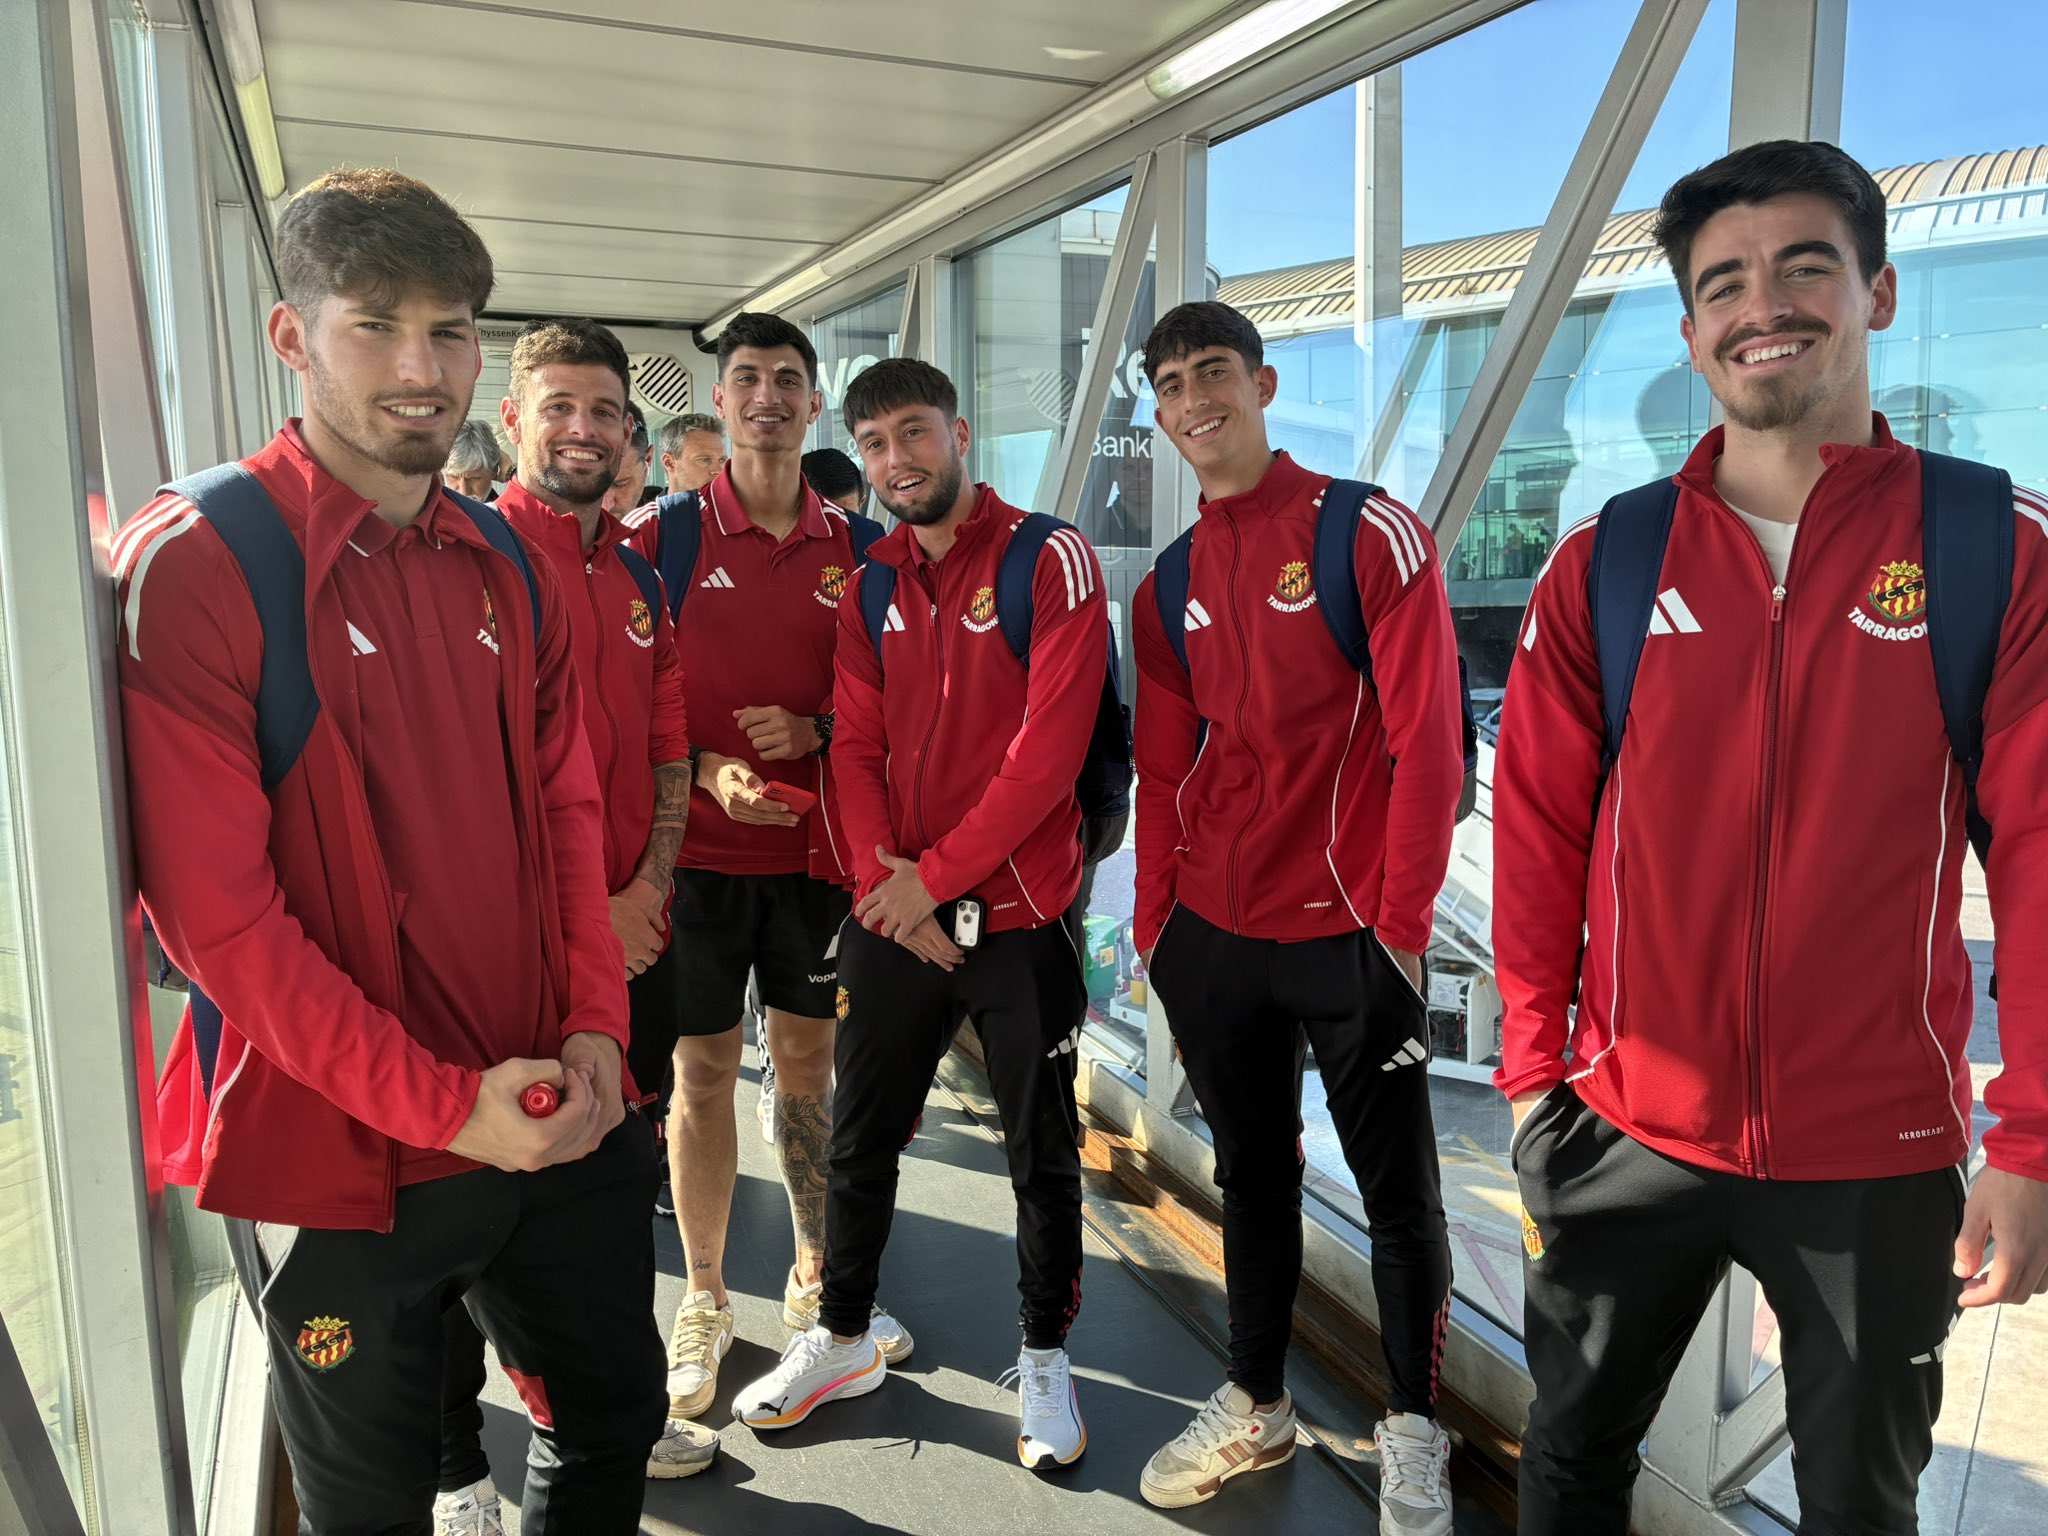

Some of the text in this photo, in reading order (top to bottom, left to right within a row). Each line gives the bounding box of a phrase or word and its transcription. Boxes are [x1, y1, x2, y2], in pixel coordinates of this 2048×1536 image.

[960, 613, 1000, 633] TARRAGON
[807, 971, 838, 984] Vopa
[1898, 1125, 1945, 1141] AEROREADY
